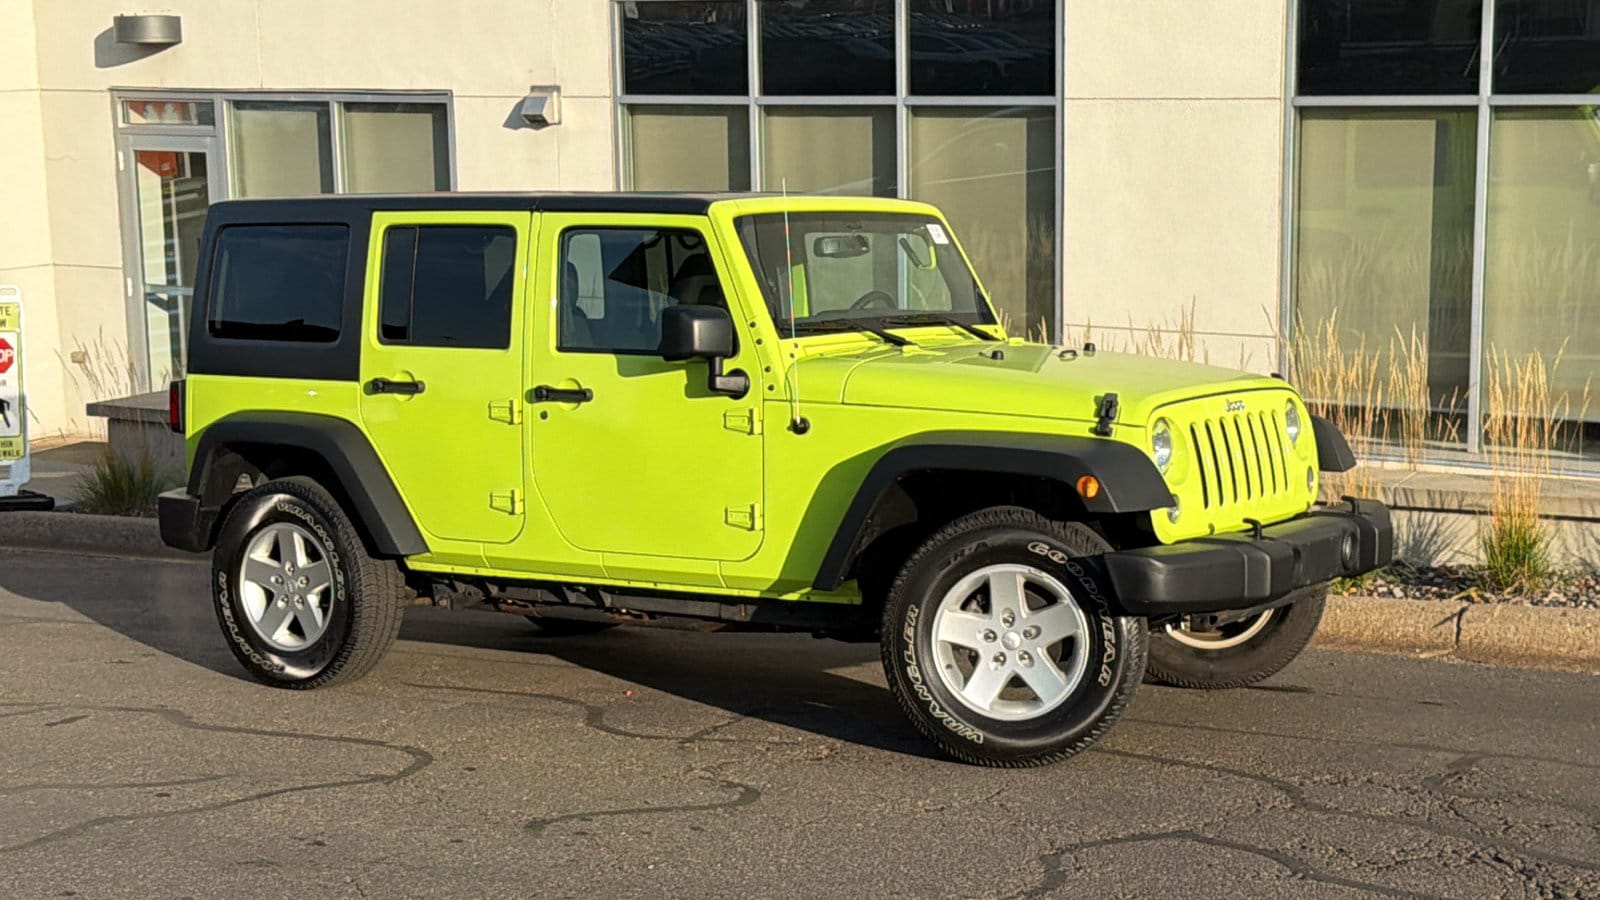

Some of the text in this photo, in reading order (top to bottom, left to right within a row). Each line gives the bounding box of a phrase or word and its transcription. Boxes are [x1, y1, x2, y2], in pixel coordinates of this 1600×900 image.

[1225, 399, 1245, 412] Jeep
[903, 603, 984, 744] WRANGLER
[1026, 541, 1117, 688] GOODYEAR
